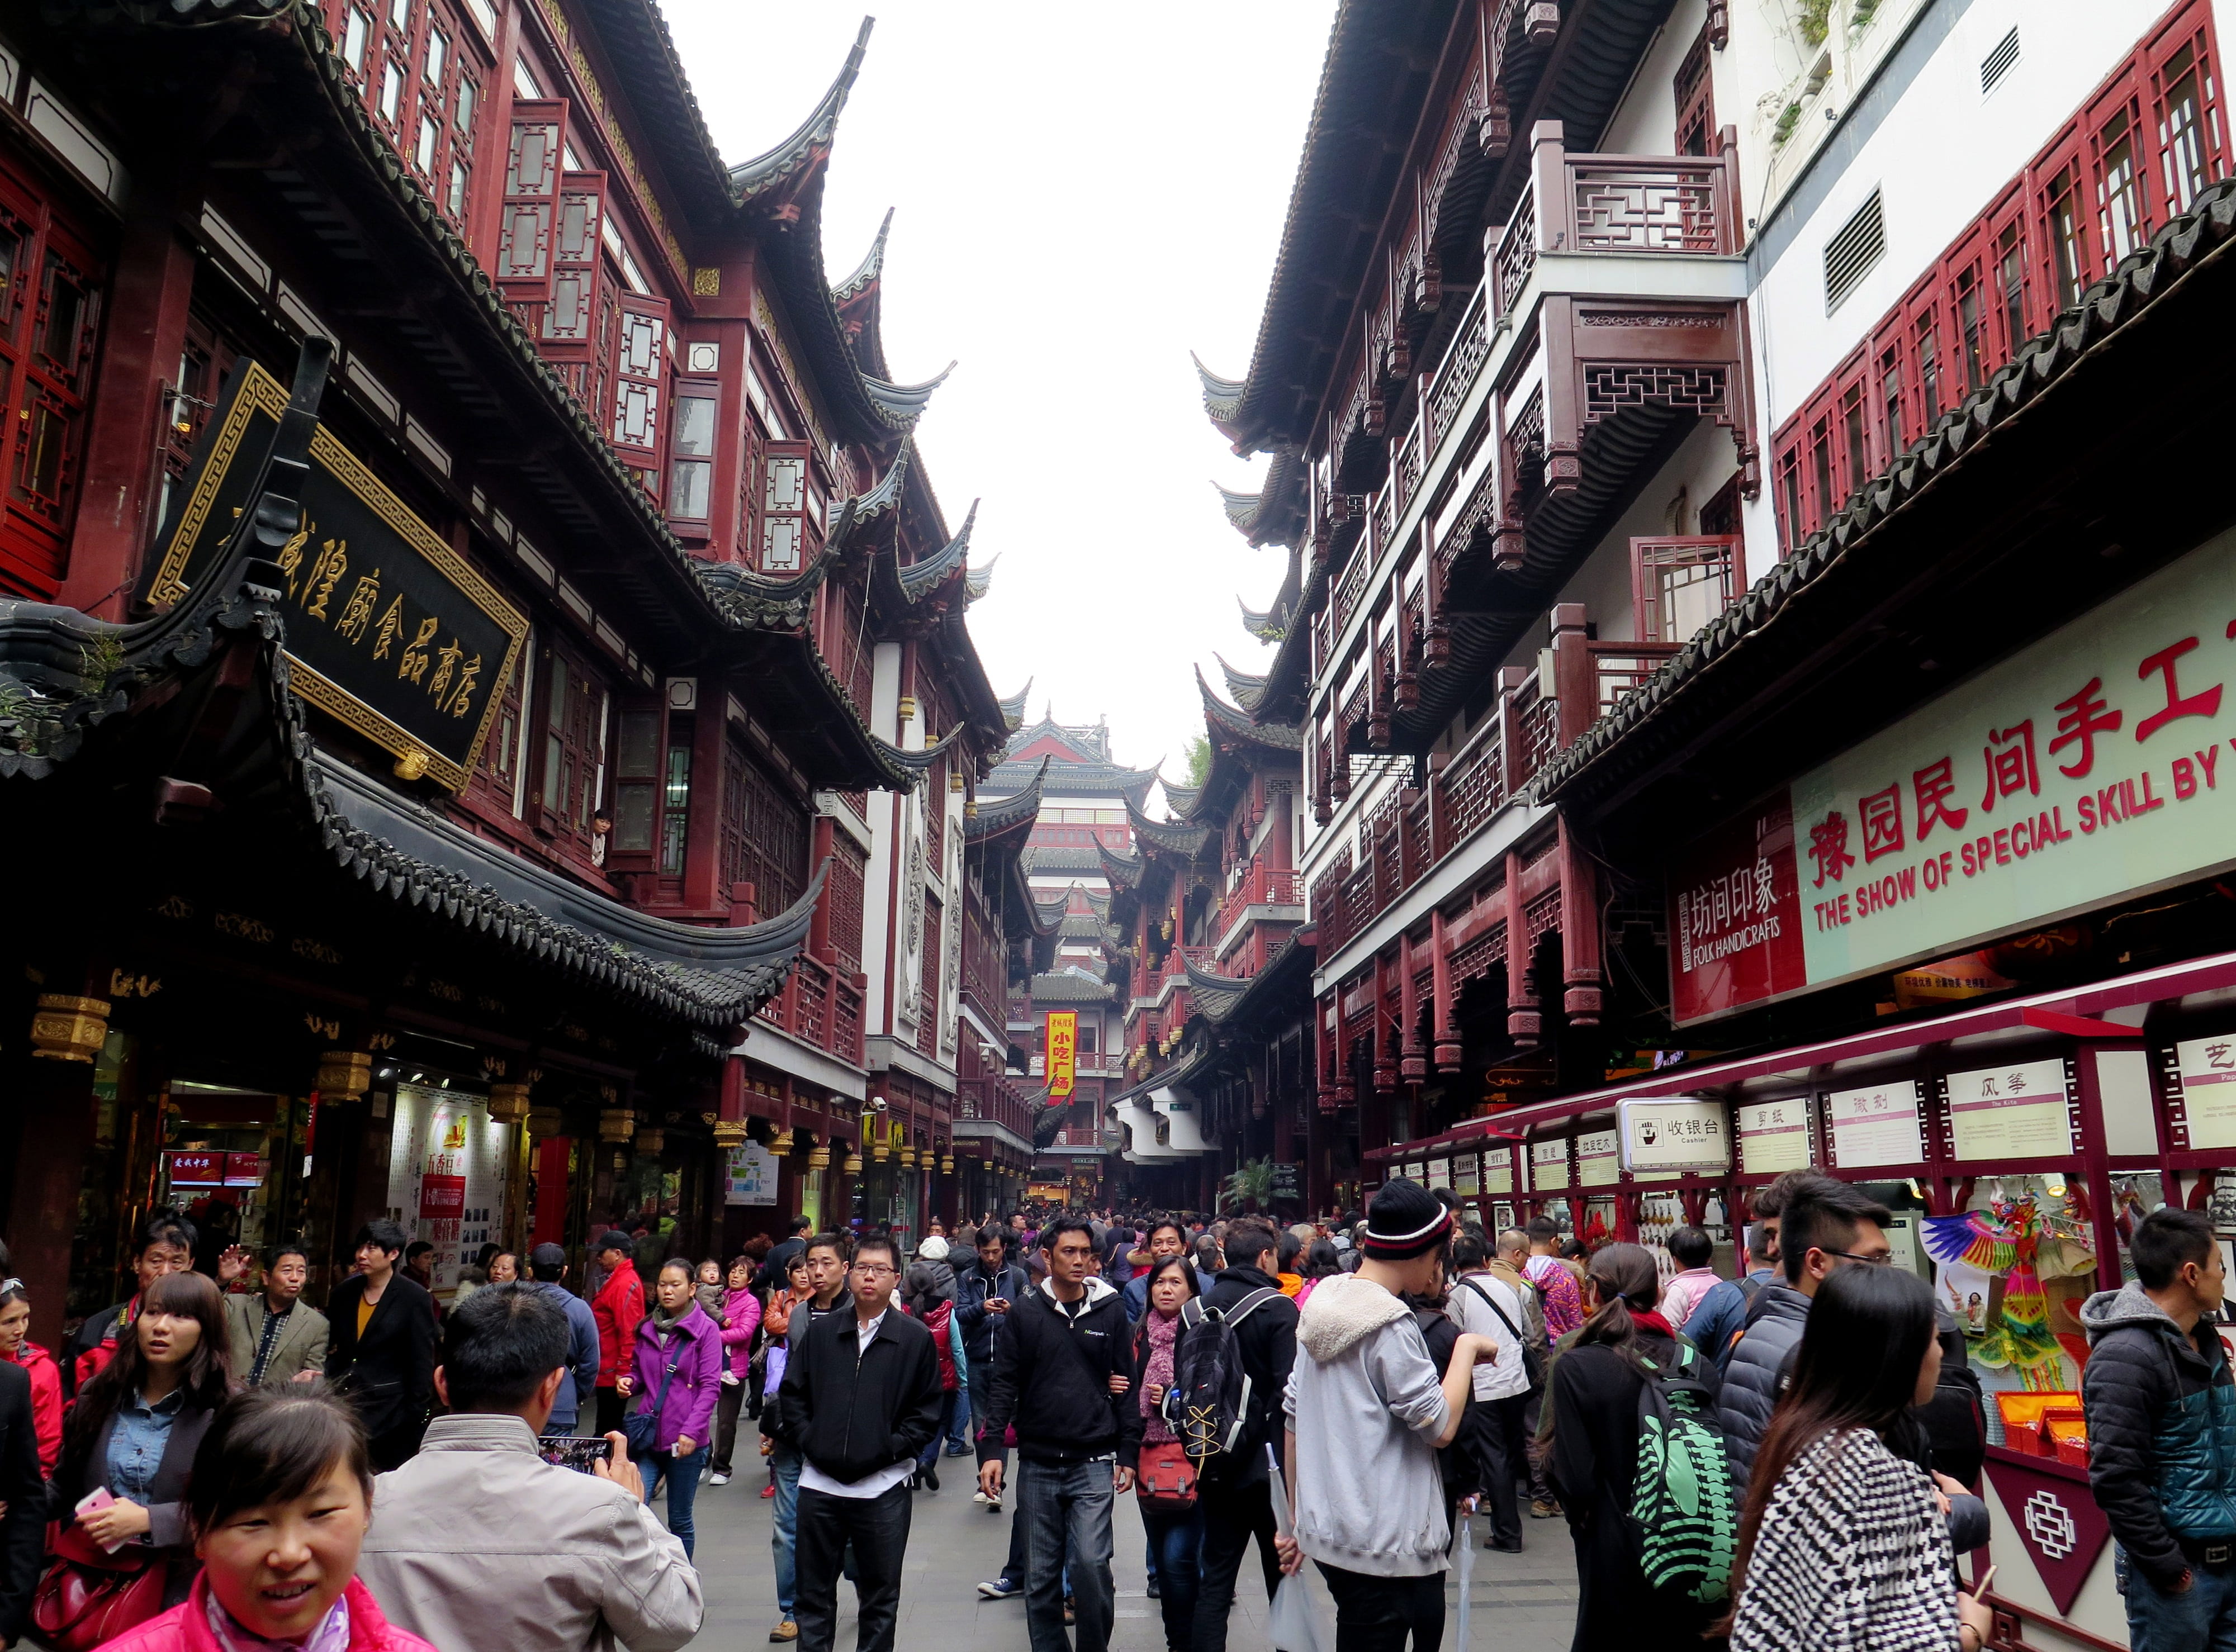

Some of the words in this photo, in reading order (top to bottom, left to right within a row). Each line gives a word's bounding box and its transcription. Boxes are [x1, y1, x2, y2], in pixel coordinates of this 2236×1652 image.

[217, 507, 481, 718] 城隍廟食品商店
[1808, 619, 2236, 889] 豫园民间手工
[1814, 894, 1851, 932] THE
[1856, 866, 1916, 918] SHOW
[1923, 851, 1953, 890] OF
[1961, 805, 2072, 877] SPECIAL
[2078, 771, 2164, 833] SKILL
[2172, 744, 2219, 800] BY
[1691, 857, 1778, 938] 坊间印象
[1693, 941, 1714, 967] FOLK
[1716, 915, 1780, 959] HANDICRAFTS
[1053, 1032, 1070, 1090] 小吃广场
[1982, 1072, 2027, 1097] 风筝
[1667, 1119, 1718, 1136] 收银台
[1757, 1109, 1784, 1127] 剪纸
[428, 1153, 454, 1175] 五香豆
